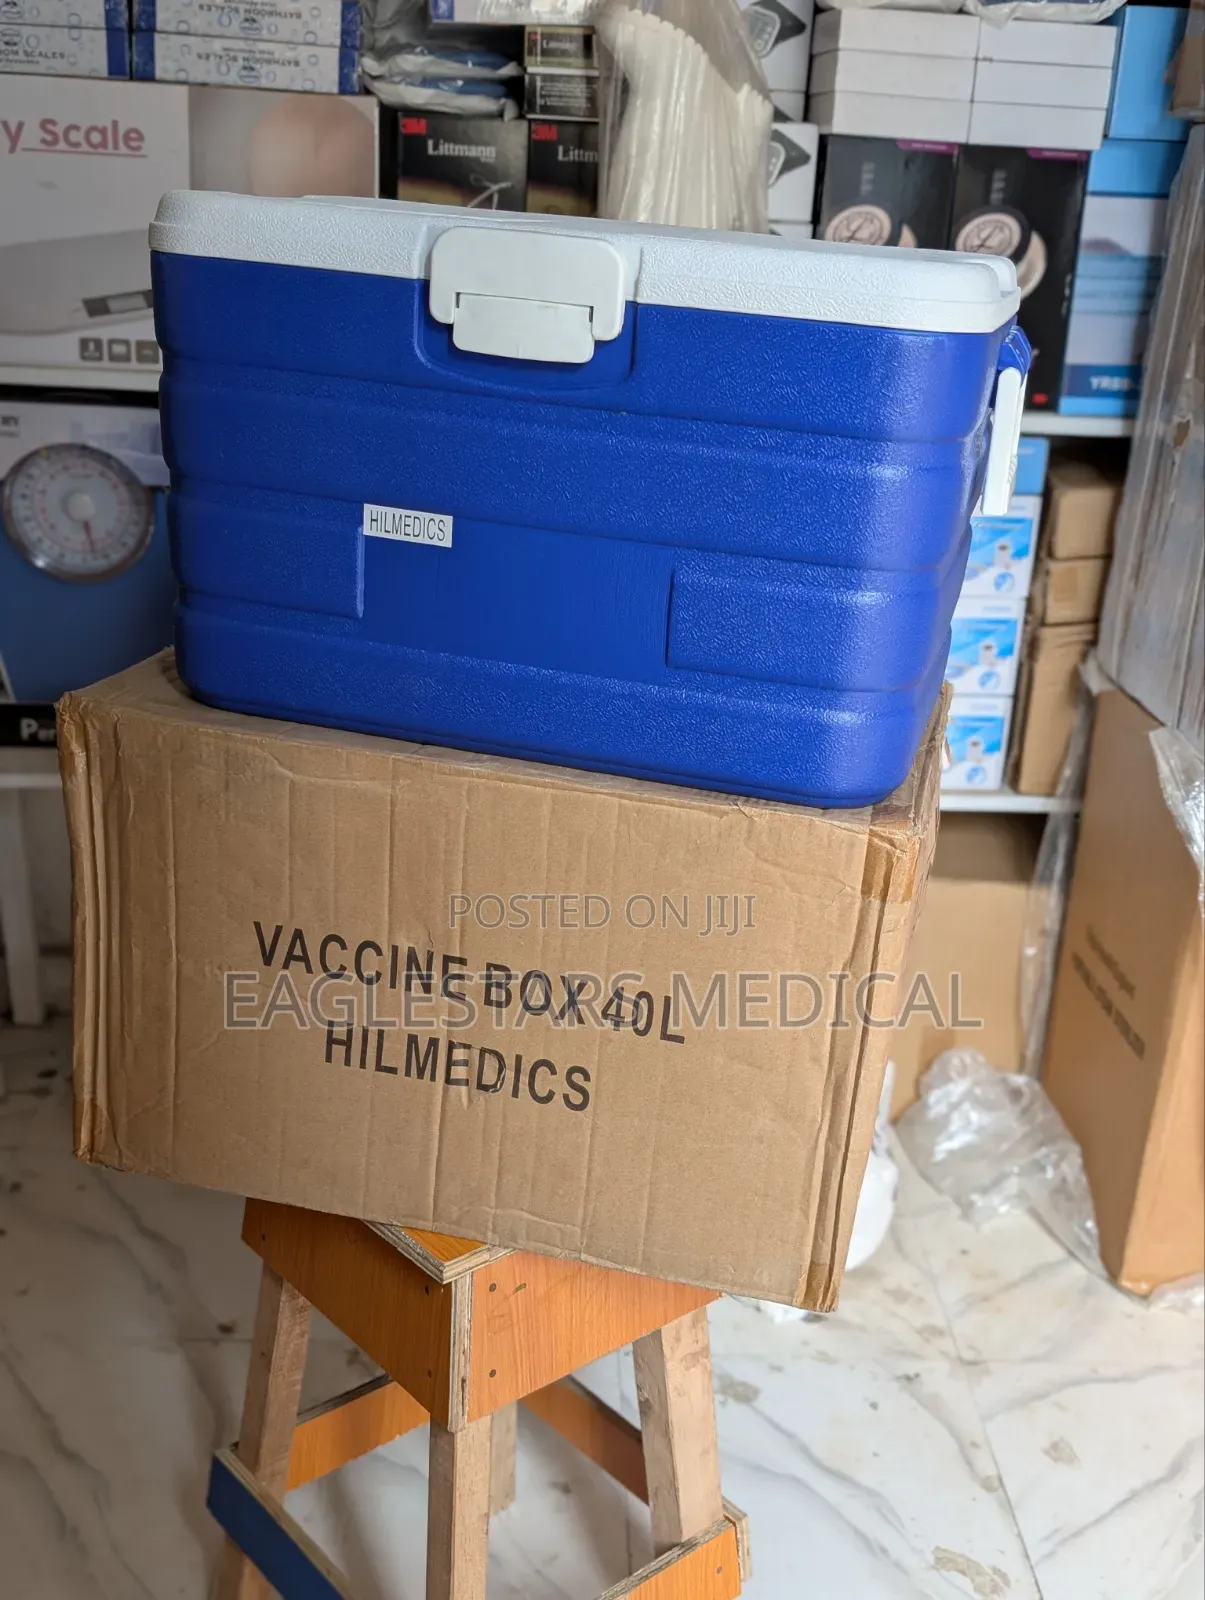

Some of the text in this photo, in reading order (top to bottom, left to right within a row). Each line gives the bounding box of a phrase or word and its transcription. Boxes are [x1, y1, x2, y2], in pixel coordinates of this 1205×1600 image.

[198, 3, 240, 15] SCALES
[23, 49, 65, 60] SCALES
[196, 52, 239, 63] SCALES
[39, 118, 145, 152] Scale
[427, 138, 496, 158] Littmann
[369, 509, 446, 542] HILMEDICS
[253, 921, 685, 1045] VACCINE BOX 40L
[324, 1019, 592, 1112] HILMEDICS
